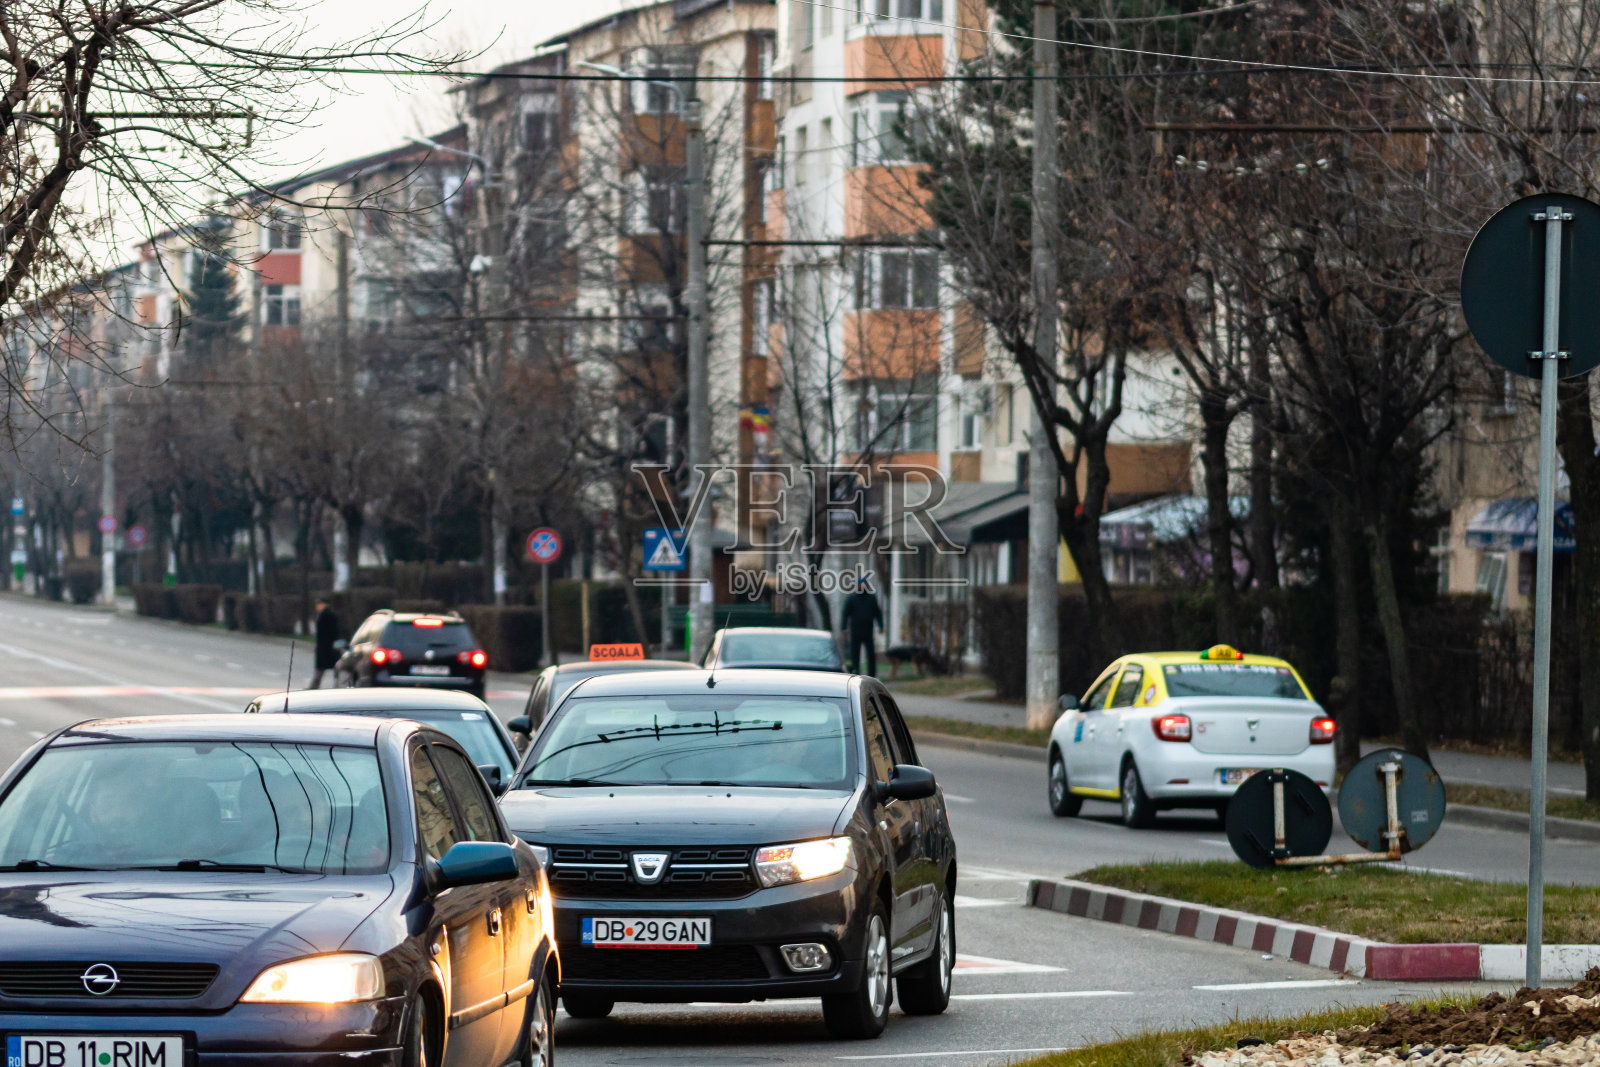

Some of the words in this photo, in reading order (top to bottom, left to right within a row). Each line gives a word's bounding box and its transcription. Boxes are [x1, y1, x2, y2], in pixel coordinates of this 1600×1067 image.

[593, 647, 640, 658] SCOALA
[595, 921, 625, 941] DB
[634, 921, 659, 941] 29
[663, 921, 706, 942] GAN
[8, 1056, 21, 1067] RO
[25, 1041, 65, 1067] DB
[78, 1041, 96, 1067] 11
[113, 1041, 166, 1067] RIM
